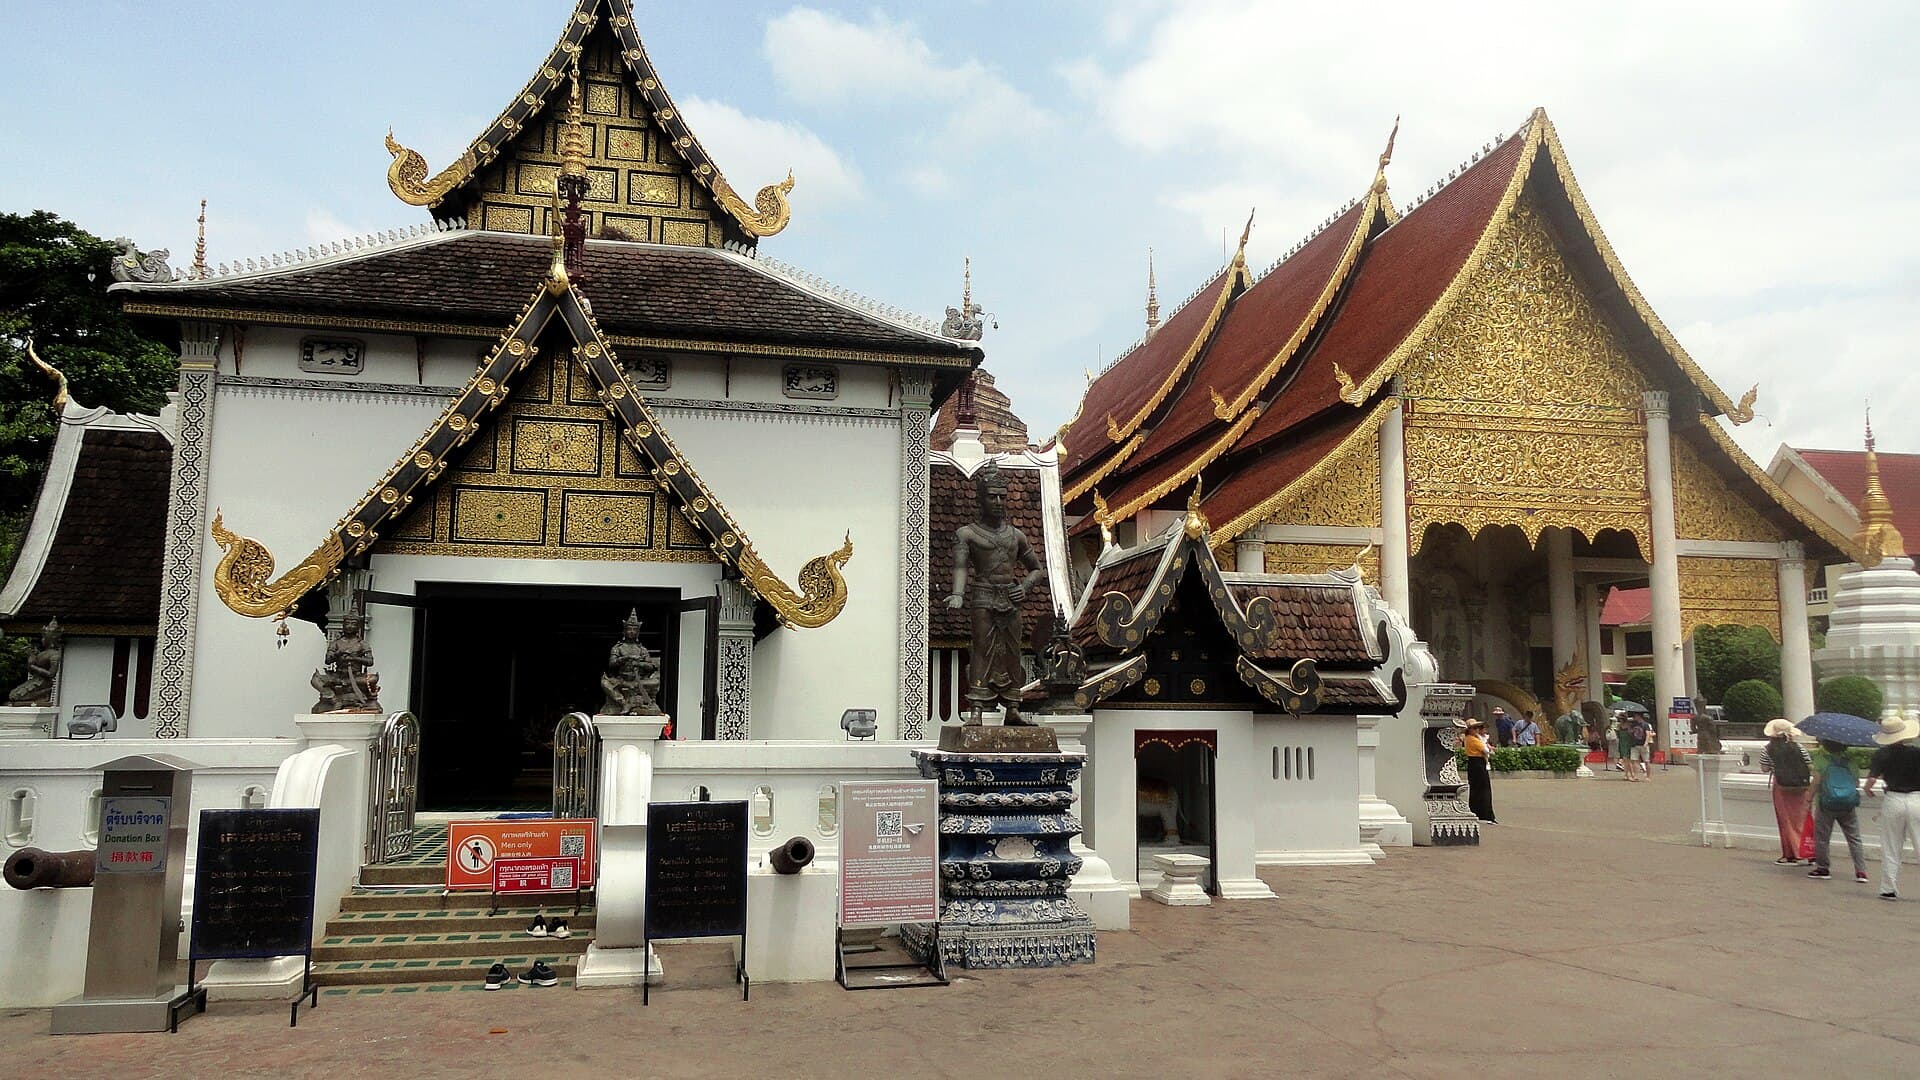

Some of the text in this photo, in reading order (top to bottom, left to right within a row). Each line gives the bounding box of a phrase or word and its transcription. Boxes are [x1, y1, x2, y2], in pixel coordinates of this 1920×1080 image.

[106, 808, 163, 831] ตู้รับบริจาค
[104, 833, 161, 843] Donation Box
[517, 841, 532, 849] only
